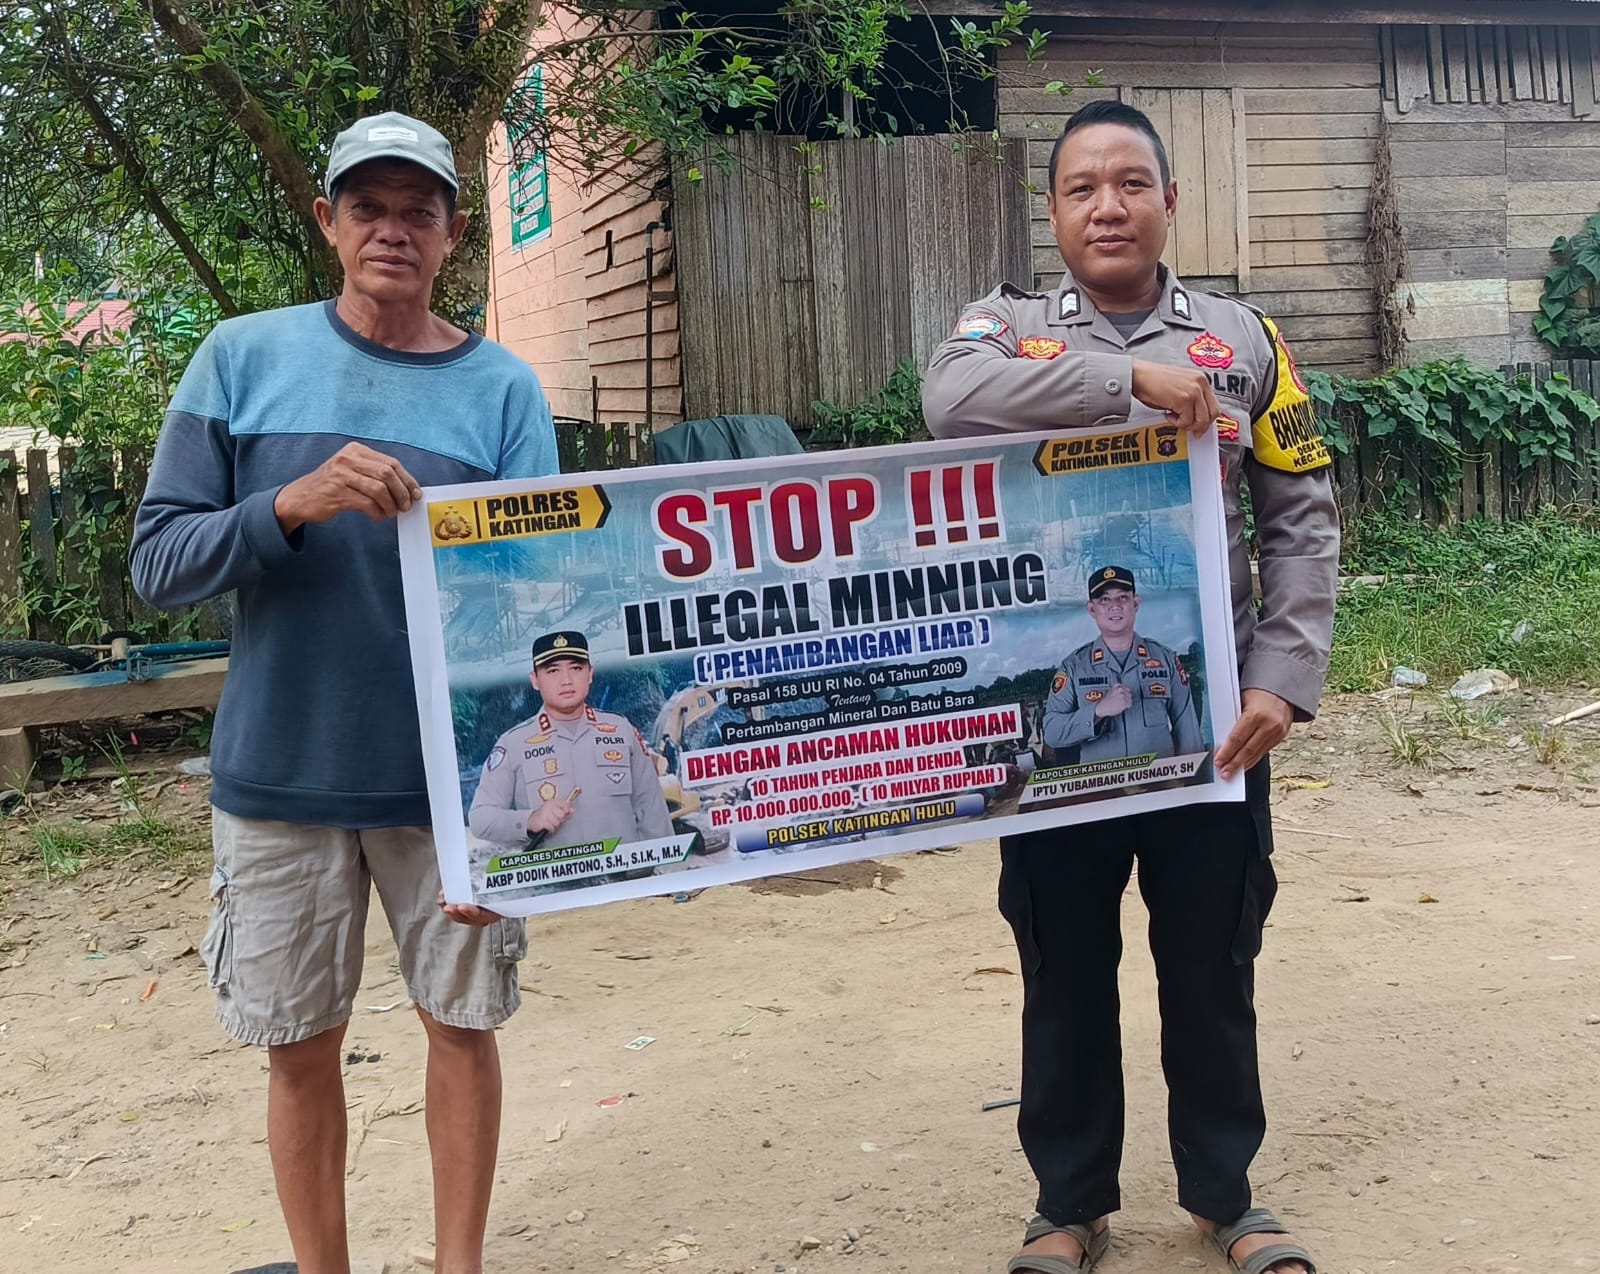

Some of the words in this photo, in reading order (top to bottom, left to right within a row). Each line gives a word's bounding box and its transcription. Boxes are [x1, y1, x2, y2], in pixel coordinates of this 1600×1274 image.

[1051, 454, 1108, 472] KATINGAN
[1111, 450, 1141, 465] HULU
[1052, 432, 1140, 458] POLSEK
[487, 490, 580, 519] POLRES
[656, 477, 876, 579] STOP
[909, 462, 999, 547] !!!
[489, 514, 581, 537] KATINGAN
[625, 581, 820, 656] ILLEGAL
[829, 553, 1047, 628] MINNING
[733, 688, 770, 705] Pasal
[774, 684, 798, 698] 158
[801, 680, 822, 694] UU
[825, 678, 840, 692] RI
[843, 676, 867, 689] No.
[869, 672, 885, 685] 04
[888, 667, 928, 683] Tahun
[932, 661, 962, 676] 2009
[830, 693, 871, 708] Tentang
[726, 716, 825, 740] Pertambangan
[829, 706, 877, 724] Mineral
[881, 703, 907, 717] Dan
[911, 699, 941, 713] Batu
[944, 695, 975, 708] Bara
[524, 745, 555, 760] DODIK
[595, 736, 624, 745] POLRI
[687, 745, 781, 781] DENGAN
[787, 728, 900, 763] ANCAMAN
[905, 711, 1017, 747] HUKUMAN
[751, 780, 768, 796] 10
[770, 771, 819, 793] TAHUN
[823, 762, 882, 786] PENJARA
[886, 758, 914, 776] DAN
[917, 750, 963, 771] DENDA
[1033, 784, 1058, 797] IPTU
[1060, 773, 1125, 793] YUBAMBANG
[1127, 765, 1178, 782] KUSNADY,
[1181, 762, 1194, 774] SH
[1035, 768, 1080, 781] KAPOLSEK
[1081, 761, 1124, 774] KATINGAN
[1126, 757, 1149, 767] HULU
[711, 808, 733, 826] RP.
[891, 775, 940, 798] MILYAR
[768, 822, 828, 845] POLSEK
[833, 808, 911, 833] KATINGAN
[915, 801, 956, 820] HULU
[486, 873, 514, 888] AKBP
[517, 866, 549, 883] DODIK
[552, 858, 604, 878] HARTONO,
[606, 855, 629, 868] S.H.,
[631, 849, 660, 865] S.I.K.,
[662, 845, 684, 859] M.H.
[501, 853, 551, 867] KAPOLRES
[553, 843, 603, 858] KATINGAN
